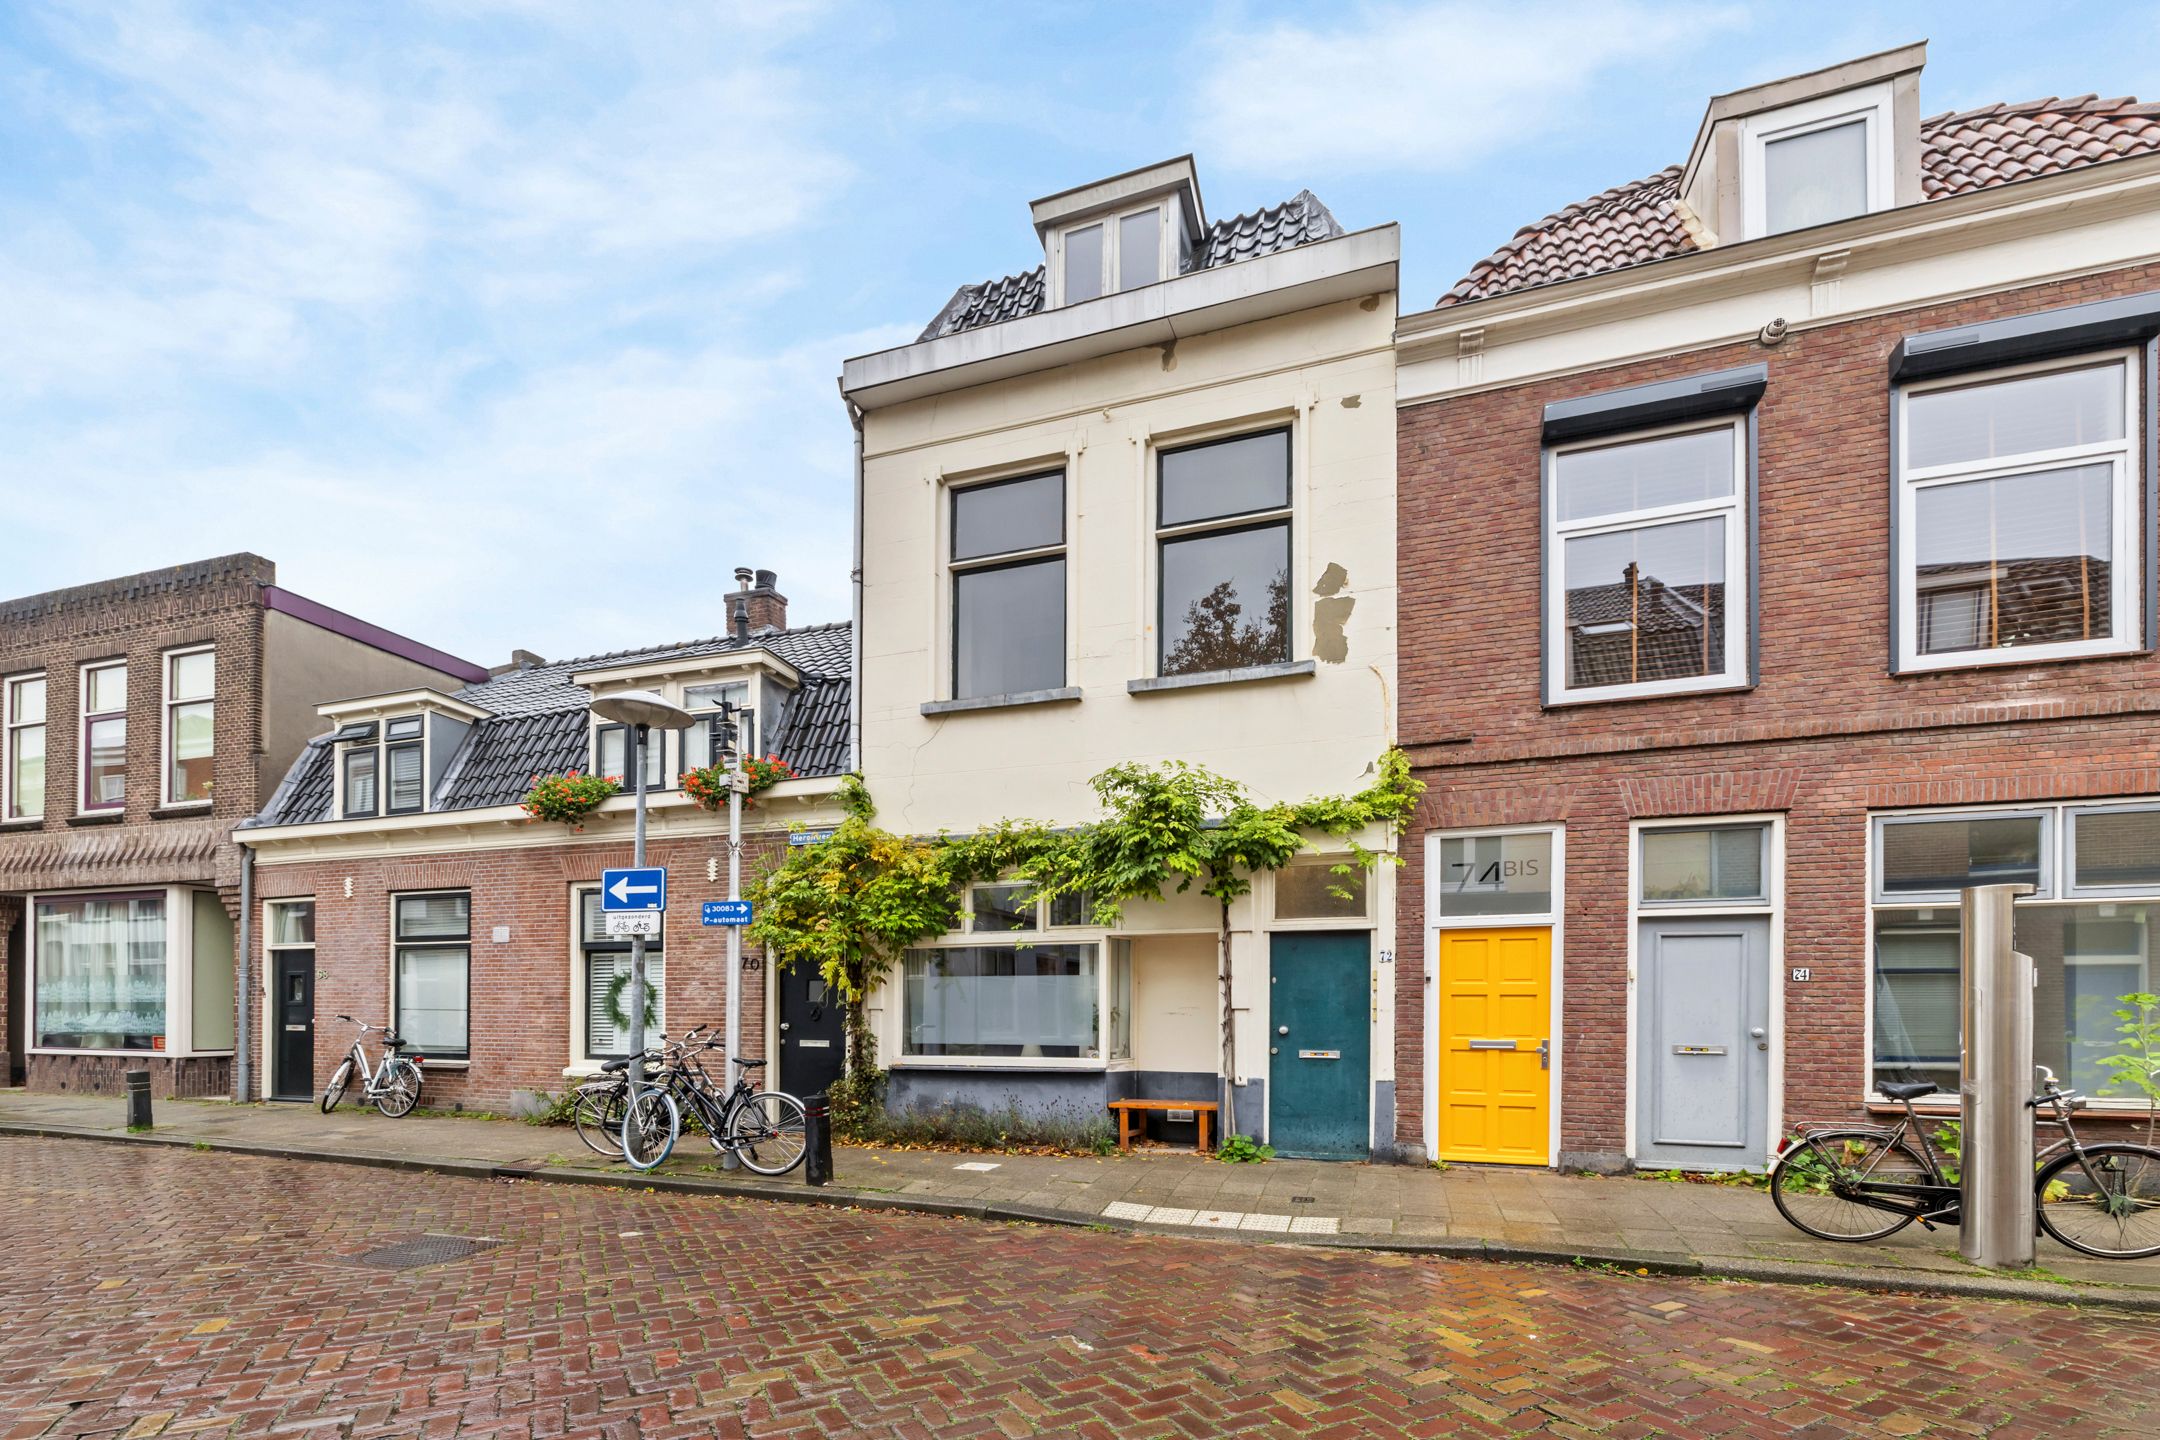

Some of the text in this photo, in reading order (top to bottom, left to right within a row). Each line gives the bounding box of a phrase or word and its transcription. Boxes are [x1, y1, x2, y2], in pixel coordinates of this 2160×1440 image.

[1504, 860, 1538, 876] BIS
[704, 916, 748, 924] P-automaat
[1380, 950, 1393, 962] 72
[741, 957, 760, 971] 70
[1794, 969, 1807, 981] 74
